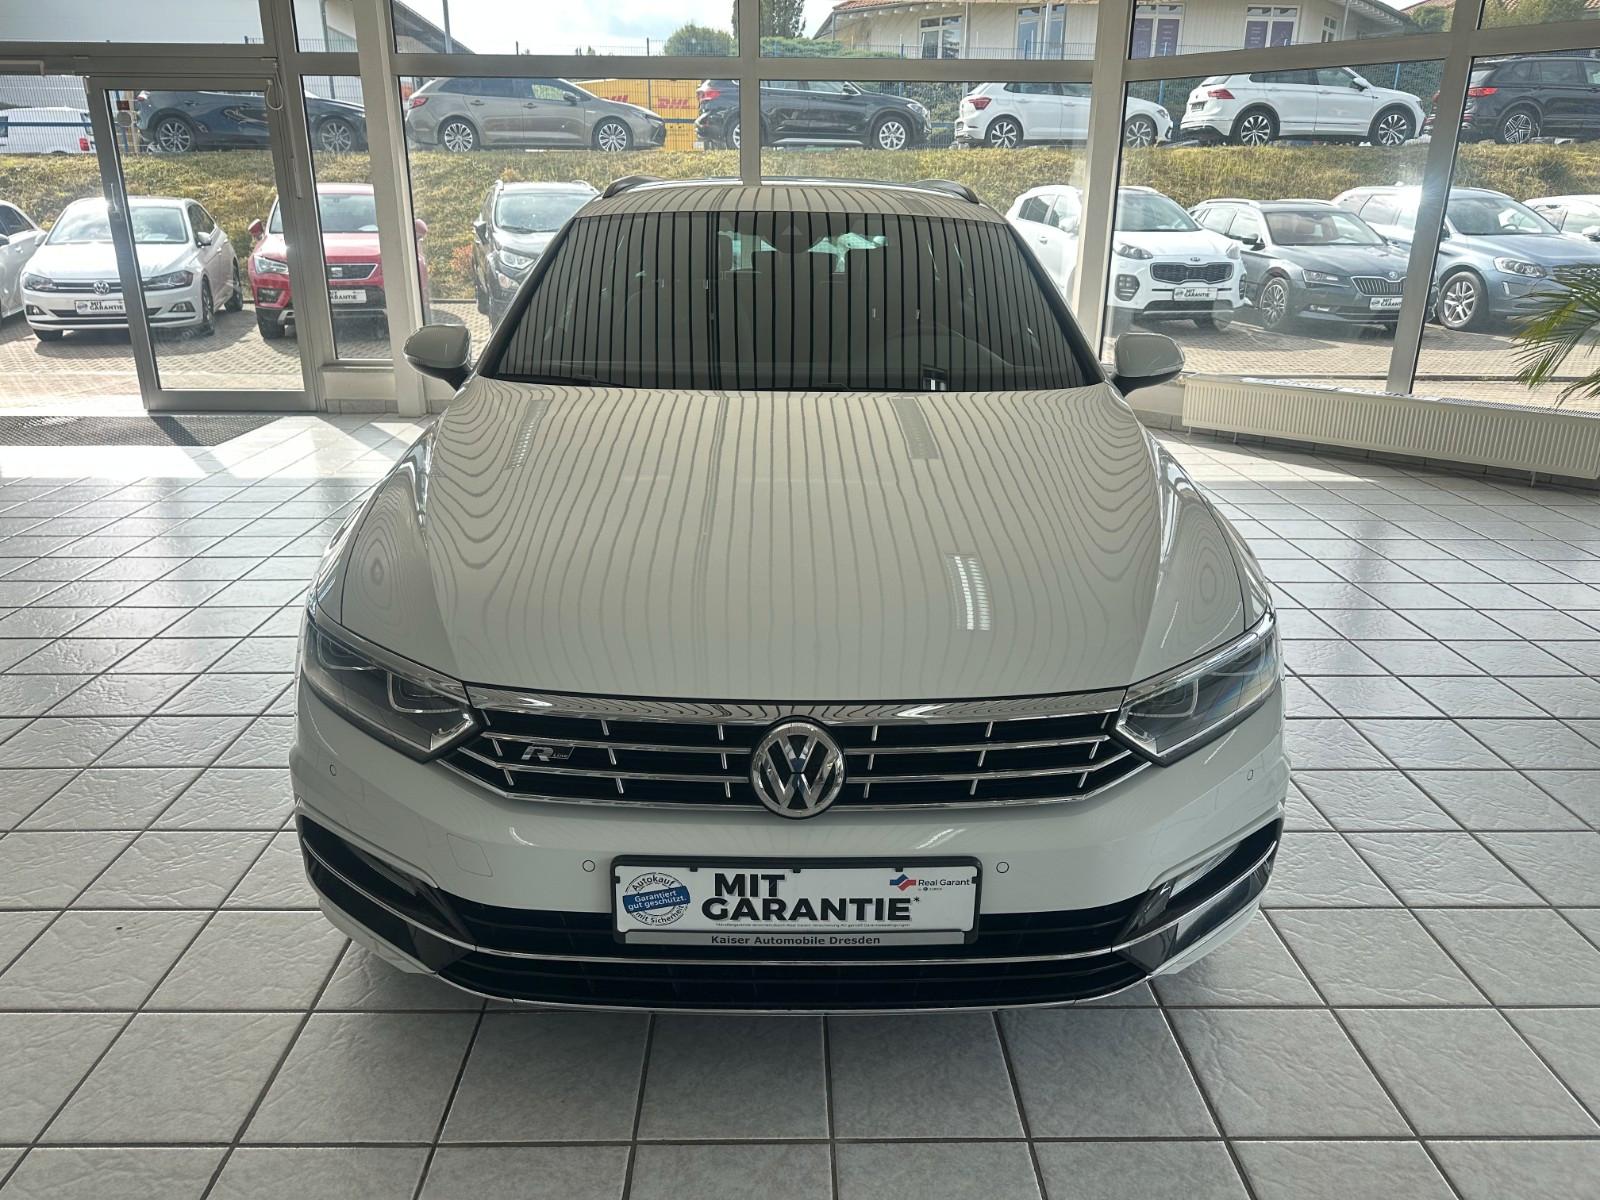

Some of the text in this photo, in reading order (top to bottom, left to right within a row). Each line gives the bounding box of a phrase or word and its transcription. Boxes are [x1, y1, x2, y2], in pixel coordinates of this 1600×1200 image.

[657, 96, 689, 109] DHL
[632, 874, 676, 892] Autokauf
[714, 873, 785, 898] MIT
[939, 878, 970, 886] Garant
[634, 890, 677, 903] Garantiert
[628, 903, 643, 911] gut
[635, 911, 649, 922] mit
[711, 935, 880, 945] Kaiser Automobile Dresden
